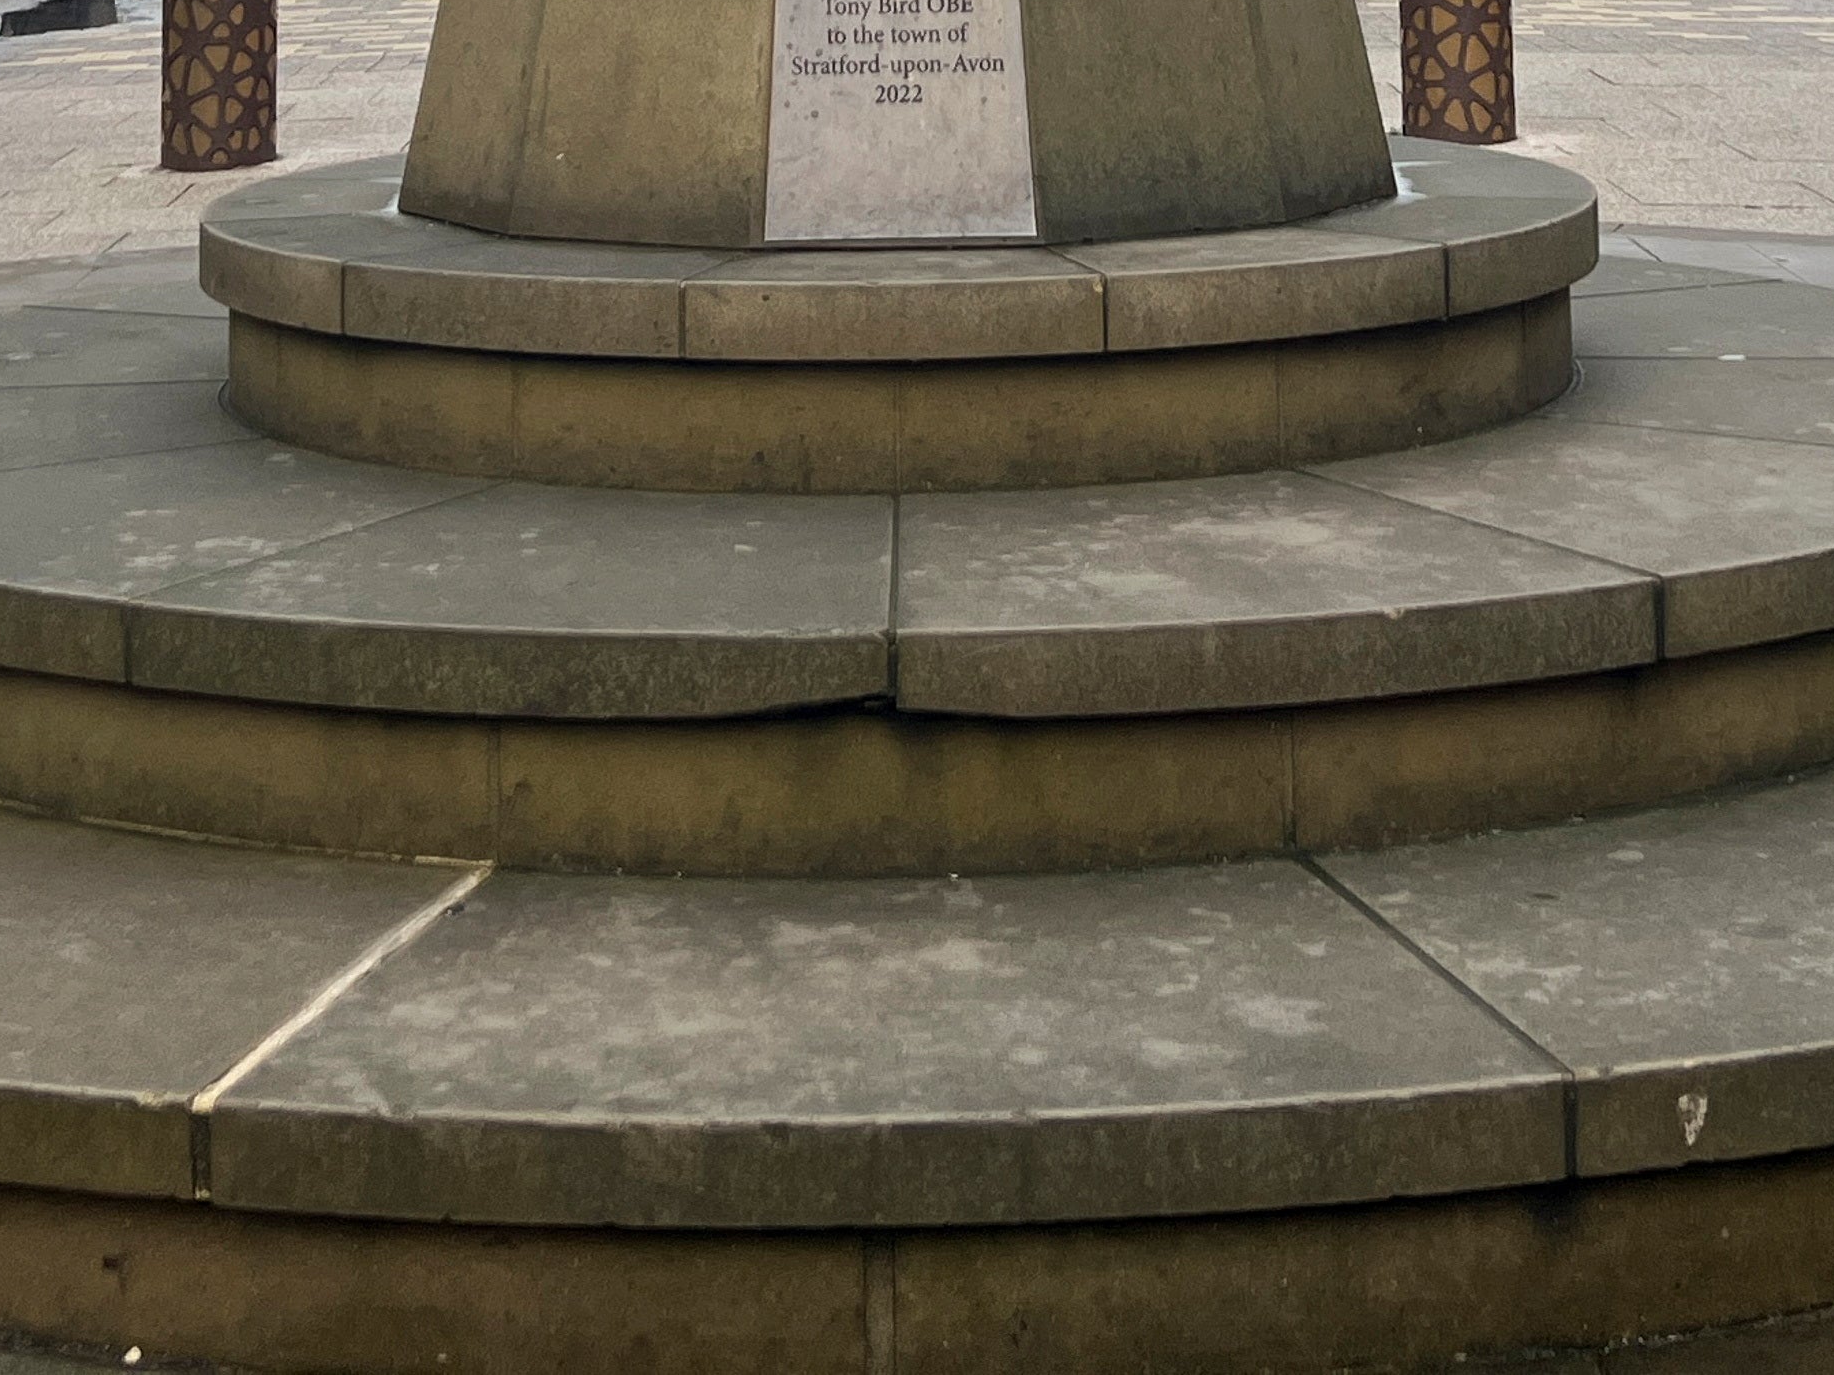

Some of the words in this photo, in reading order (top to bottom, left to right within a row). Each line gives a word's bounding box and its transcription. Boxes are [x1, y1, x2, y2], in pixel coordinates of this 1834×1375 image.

[827, 28, 847, 44] to
[853, 24, 885, 44] the
[891, 26, 941, 43] town
[947, 21, 970, 42] of
[790, 53, 1005, 79] Stratford-upon-Avon
[874, 84, 923, 104] 2022
